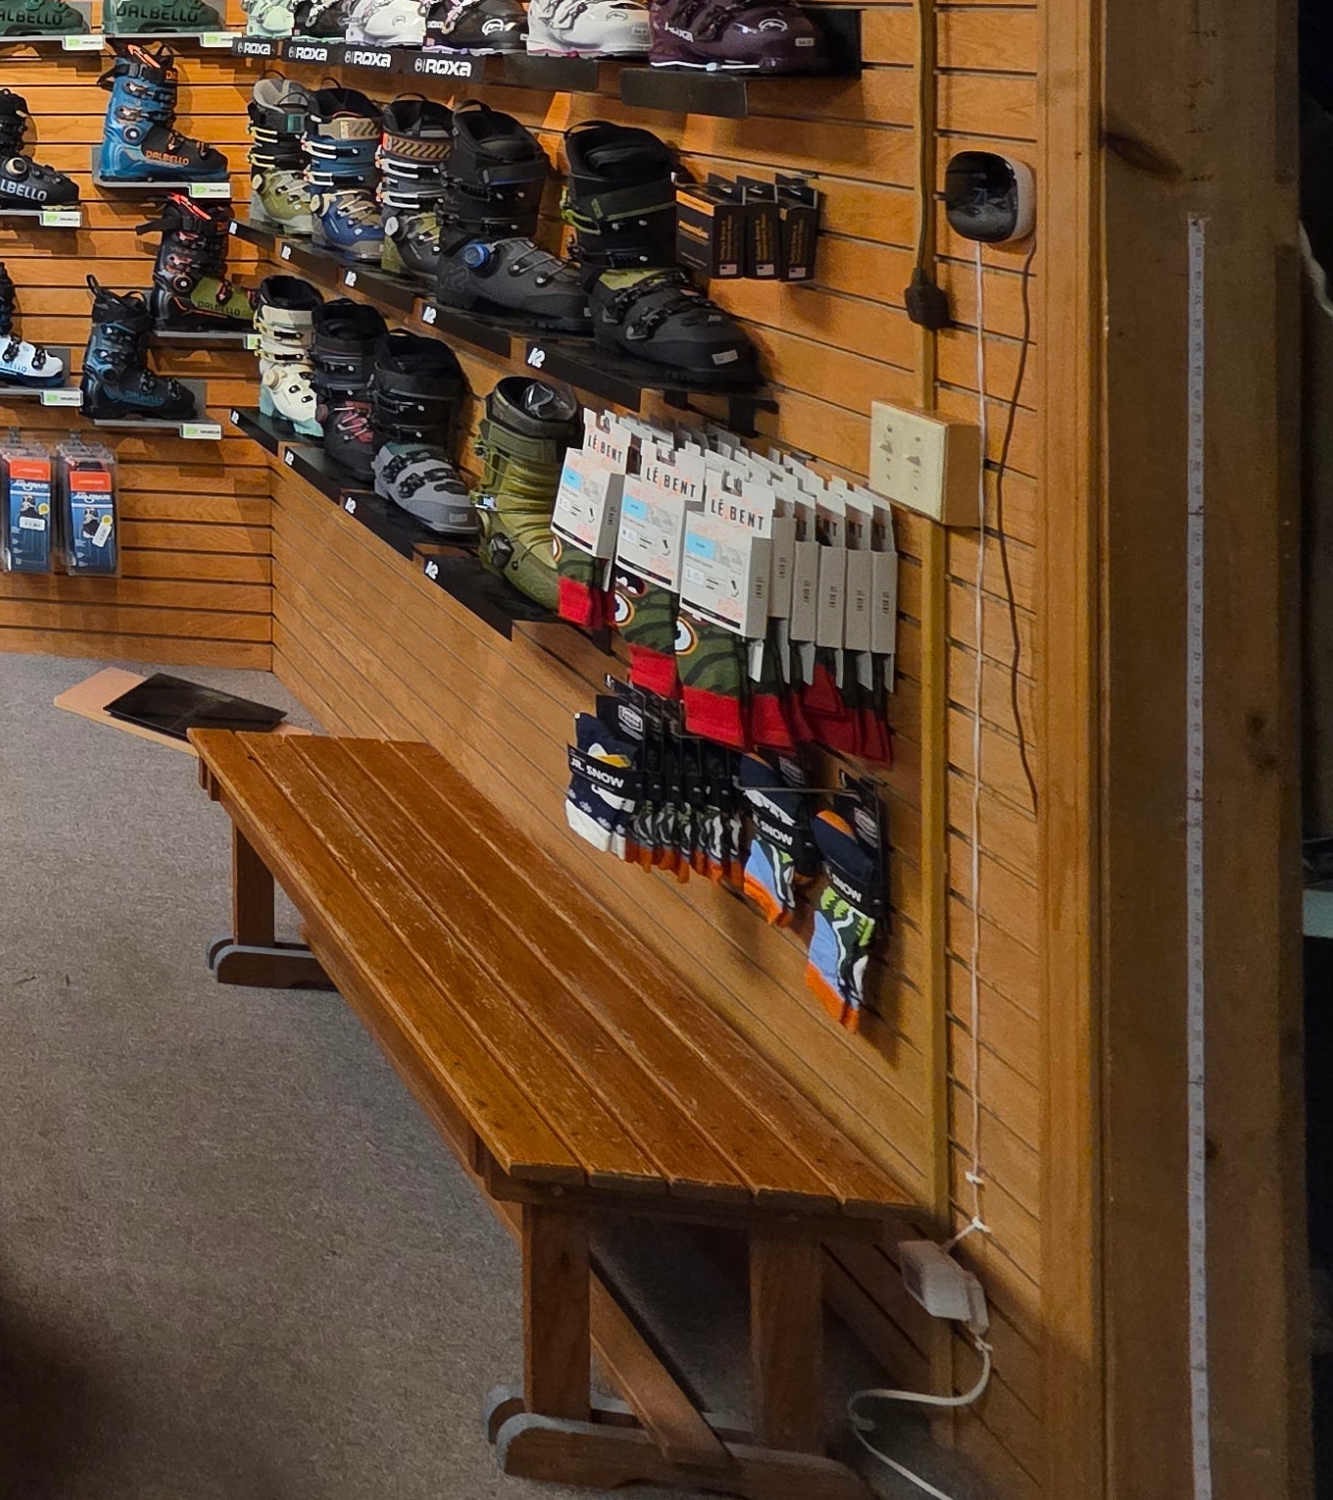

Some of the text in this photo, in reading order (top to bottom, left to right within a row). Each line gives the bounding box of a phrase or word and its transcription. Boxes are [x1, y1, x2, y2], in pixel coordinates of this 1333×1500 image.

[117, 6, 198, 22] DALBELLO
[146, 151, 190, 165] DALBELLO
[344, 271, 357, 287] K2
[197, 301, 241, 317] DALBELLO
[422, 306, 437, 325] K2
[527, 347, 546, 368] K2
[600, 439, 623, 466] BENT
[663, 473, 697, 499] BENT
[730, 504, 764, 532] BENT
[425, 560, 439, 580] K2
[585, 764, 625, 790] SNOW
[761, 820, 794, 846] SNOW
